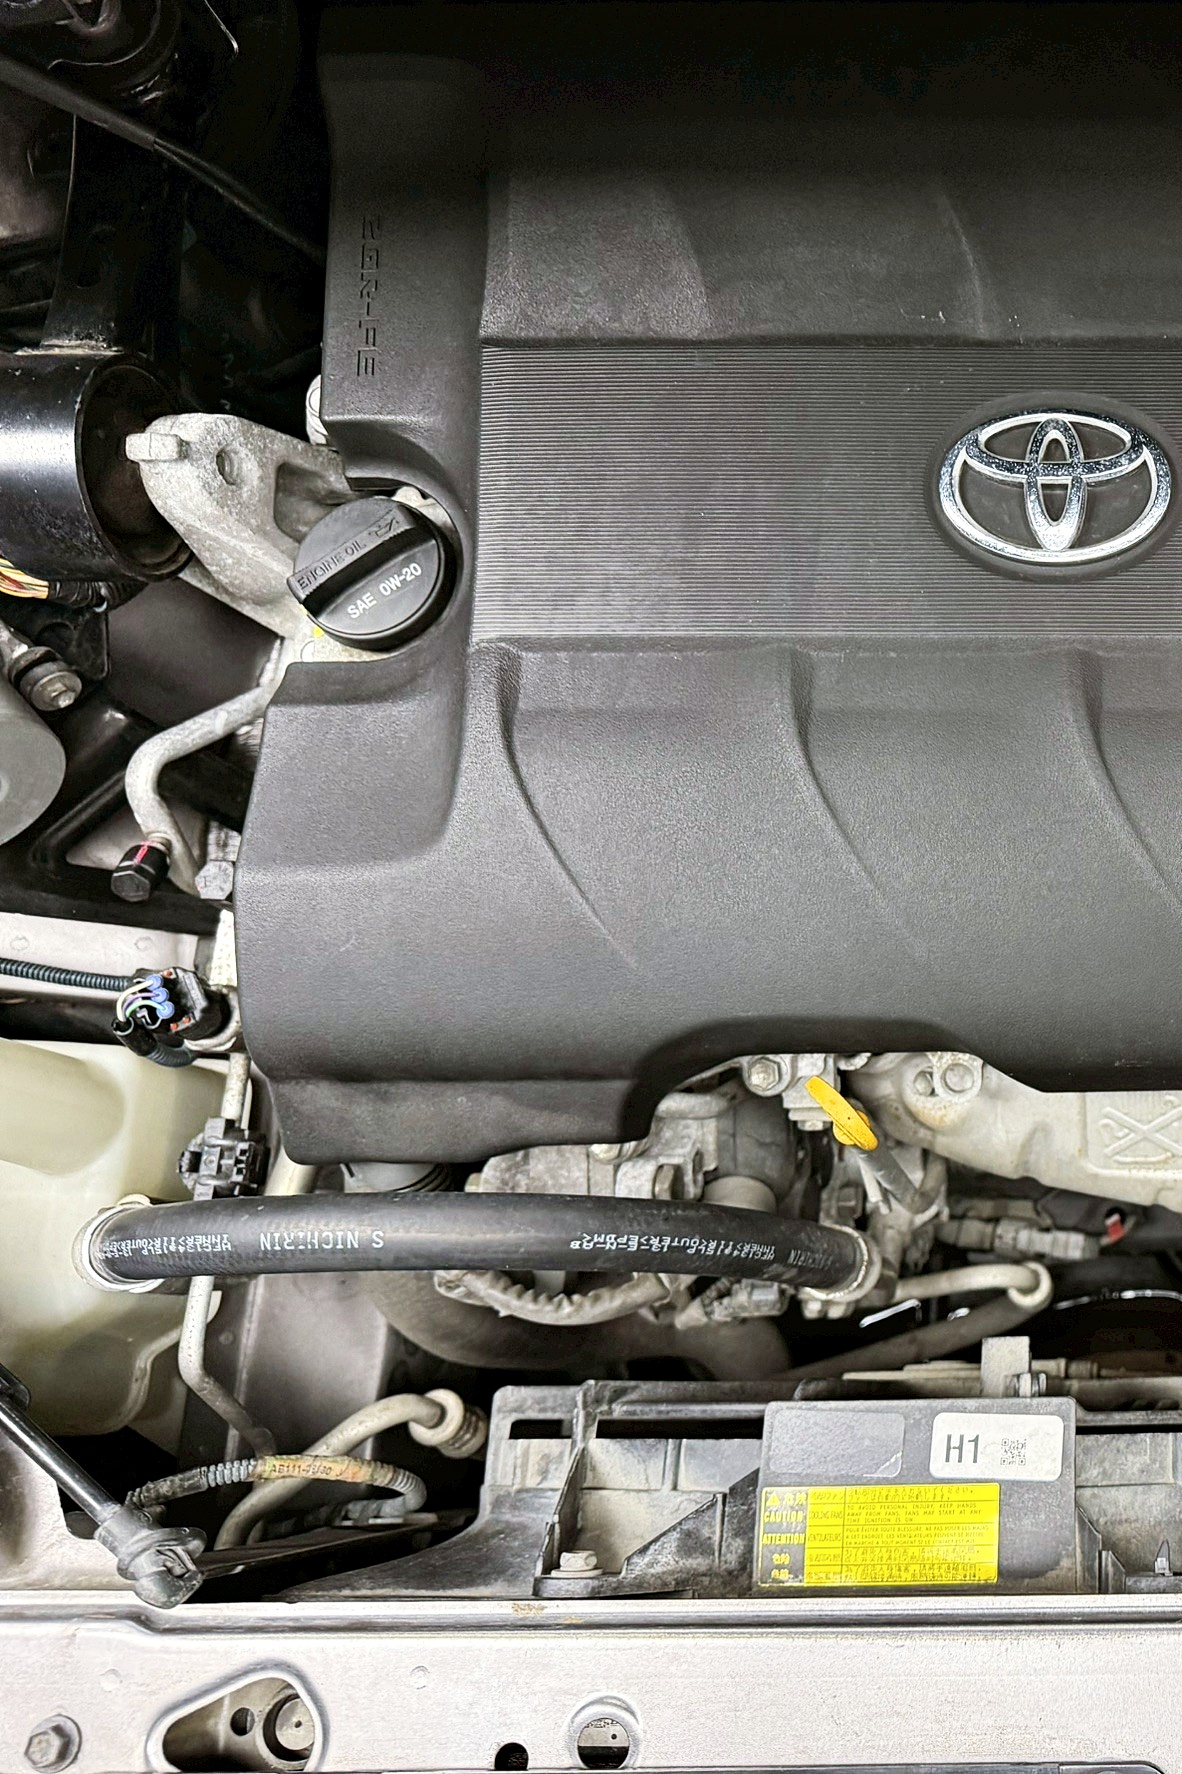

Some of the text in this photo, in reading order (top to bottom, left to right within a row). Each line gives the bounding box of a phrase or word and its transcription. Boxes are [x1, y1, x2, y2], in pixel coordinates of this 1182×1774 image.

[296, 540, 367, 590] ENGINE OIL
[347, 562, 422, 619] SAE 0W-20
[260, 1230, 385, 1251] S NICHIRIN
[945, 1434, 979, 1464] H1
[764, 1510, 804, 1523] CAUTION
[762, 1533, 806, 1544] ATTENTION
